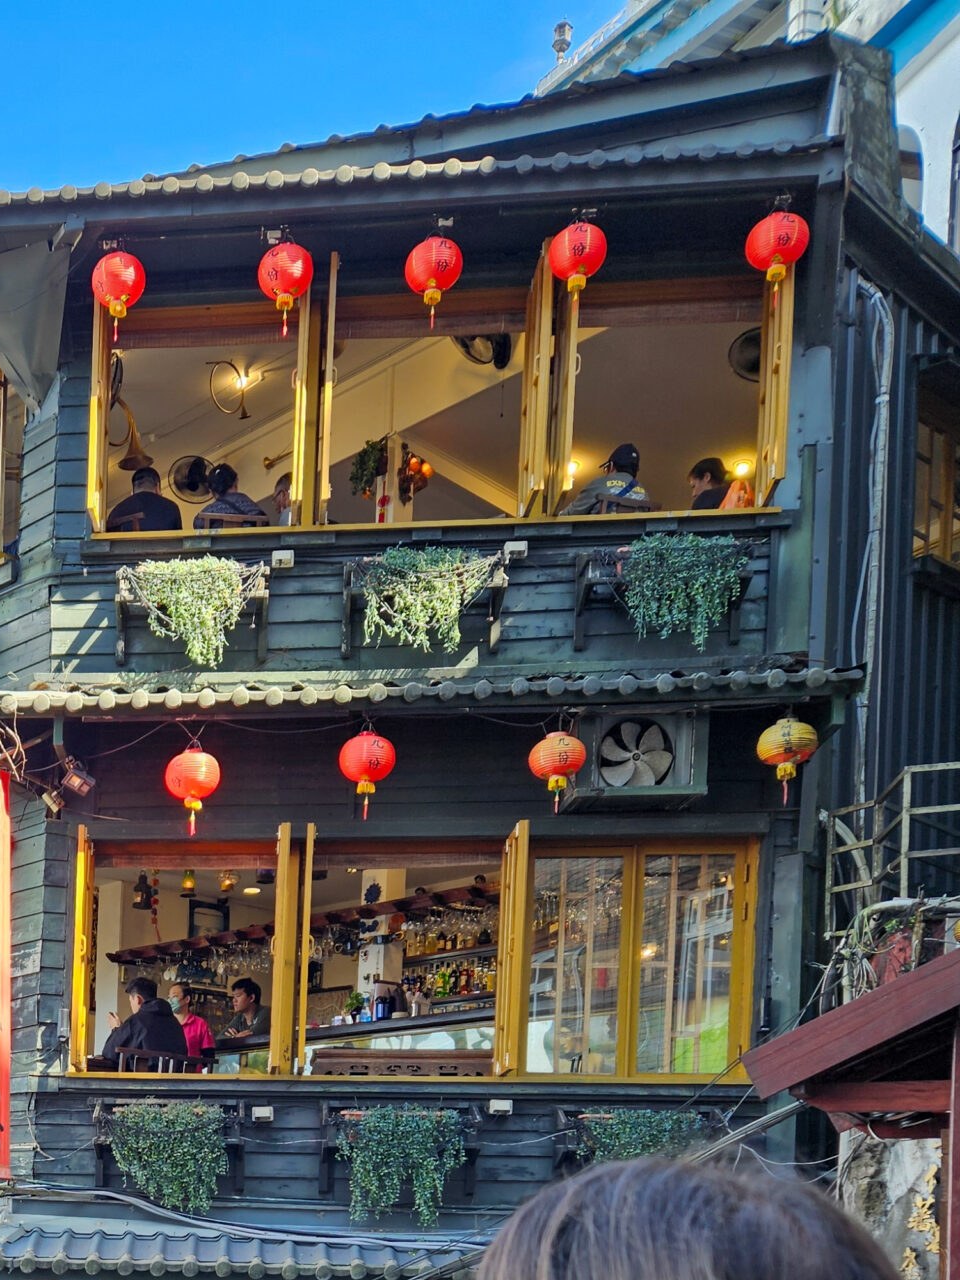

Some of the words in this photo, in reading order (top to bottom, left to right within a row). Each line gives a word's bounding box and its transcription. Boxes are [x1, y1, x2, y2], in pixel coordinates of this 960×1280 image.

[571, 222, 588, 257] 九份
[368, 738, 385, 770] 九份
[557, 737, 570, 765] 九份
